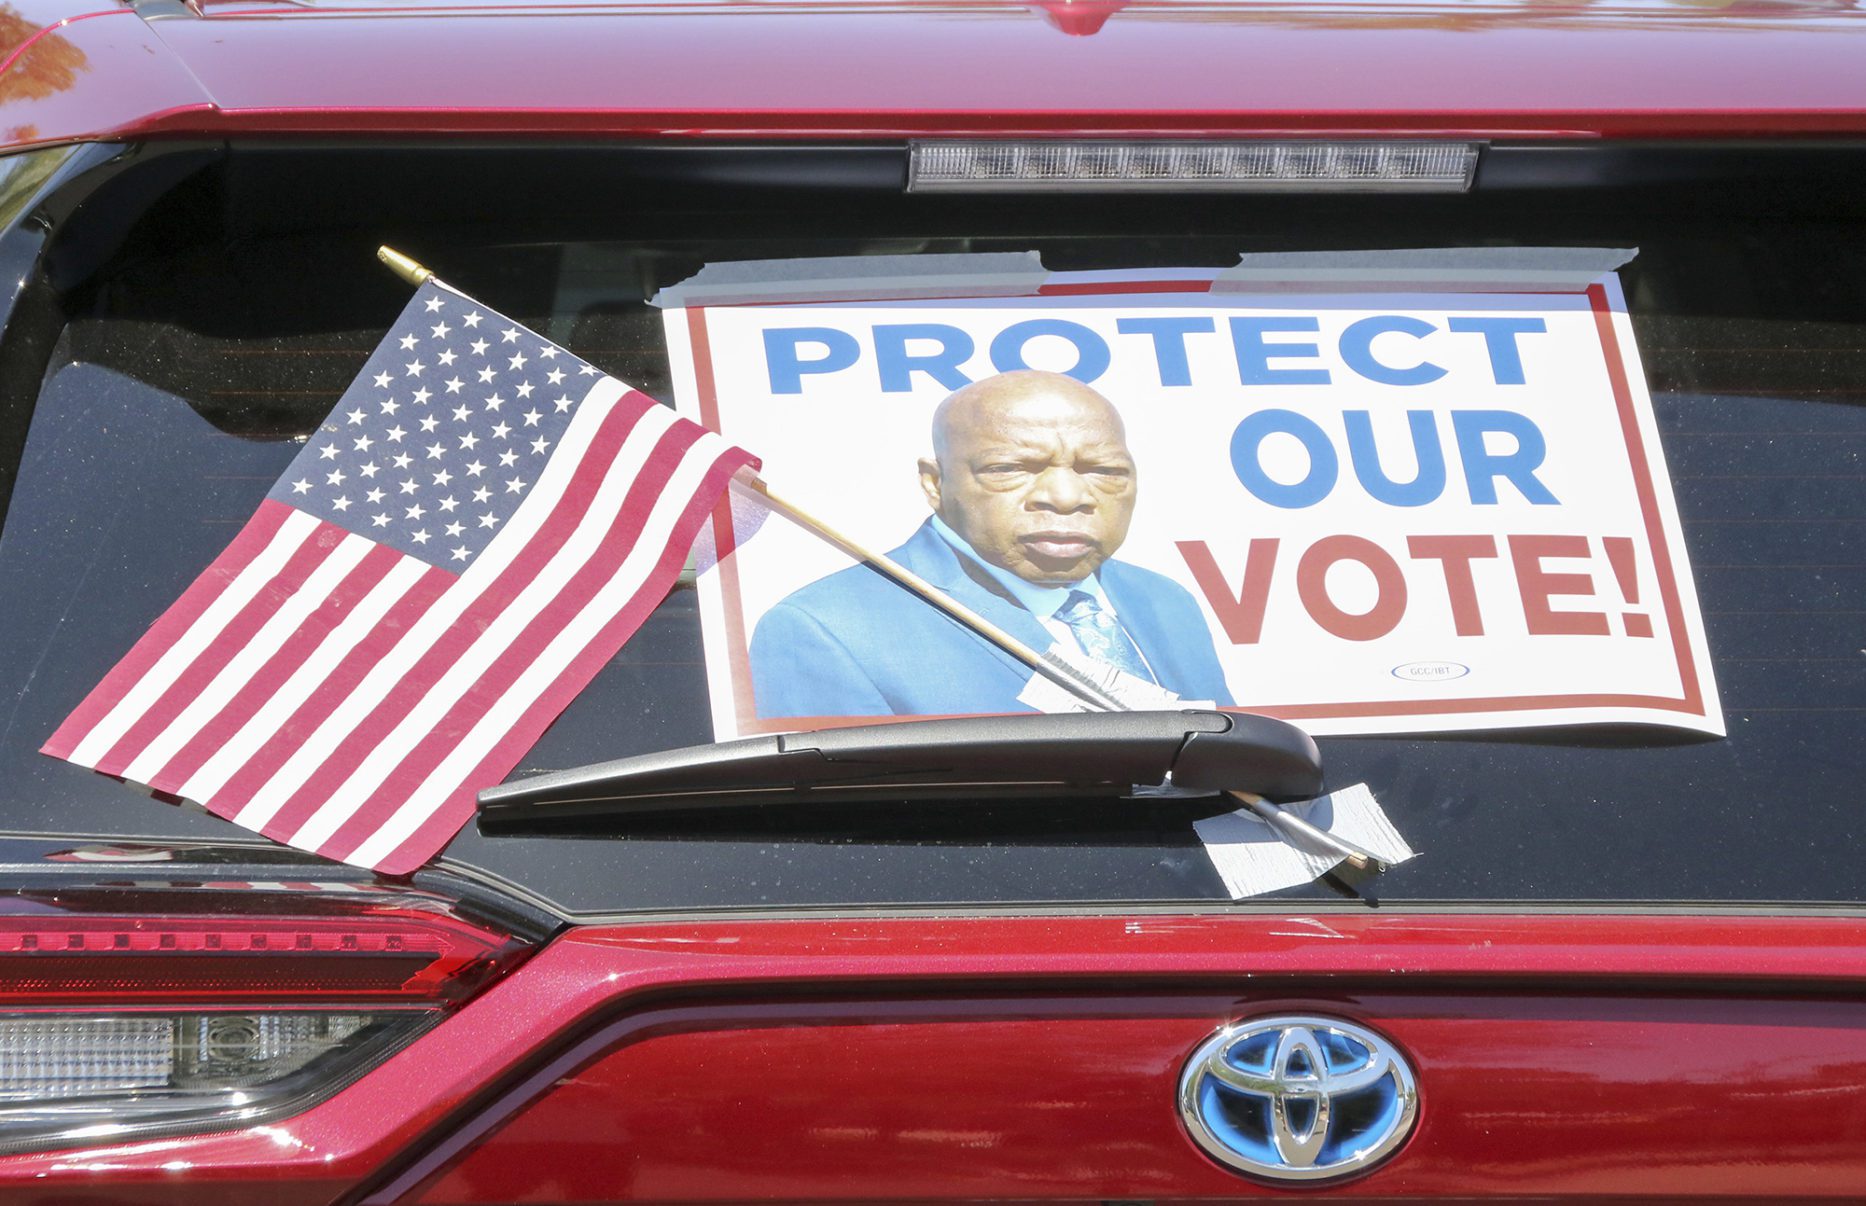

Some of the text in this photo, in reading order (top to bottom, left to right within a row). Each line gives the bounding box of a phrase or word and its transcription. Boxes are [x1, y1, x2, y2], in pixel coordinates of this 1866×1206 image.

[762, 316, 1547, 395] PROTECT
[1229, 408, 1561, 509] OUR
[1174, 534, 1655, 645] VOTE!
